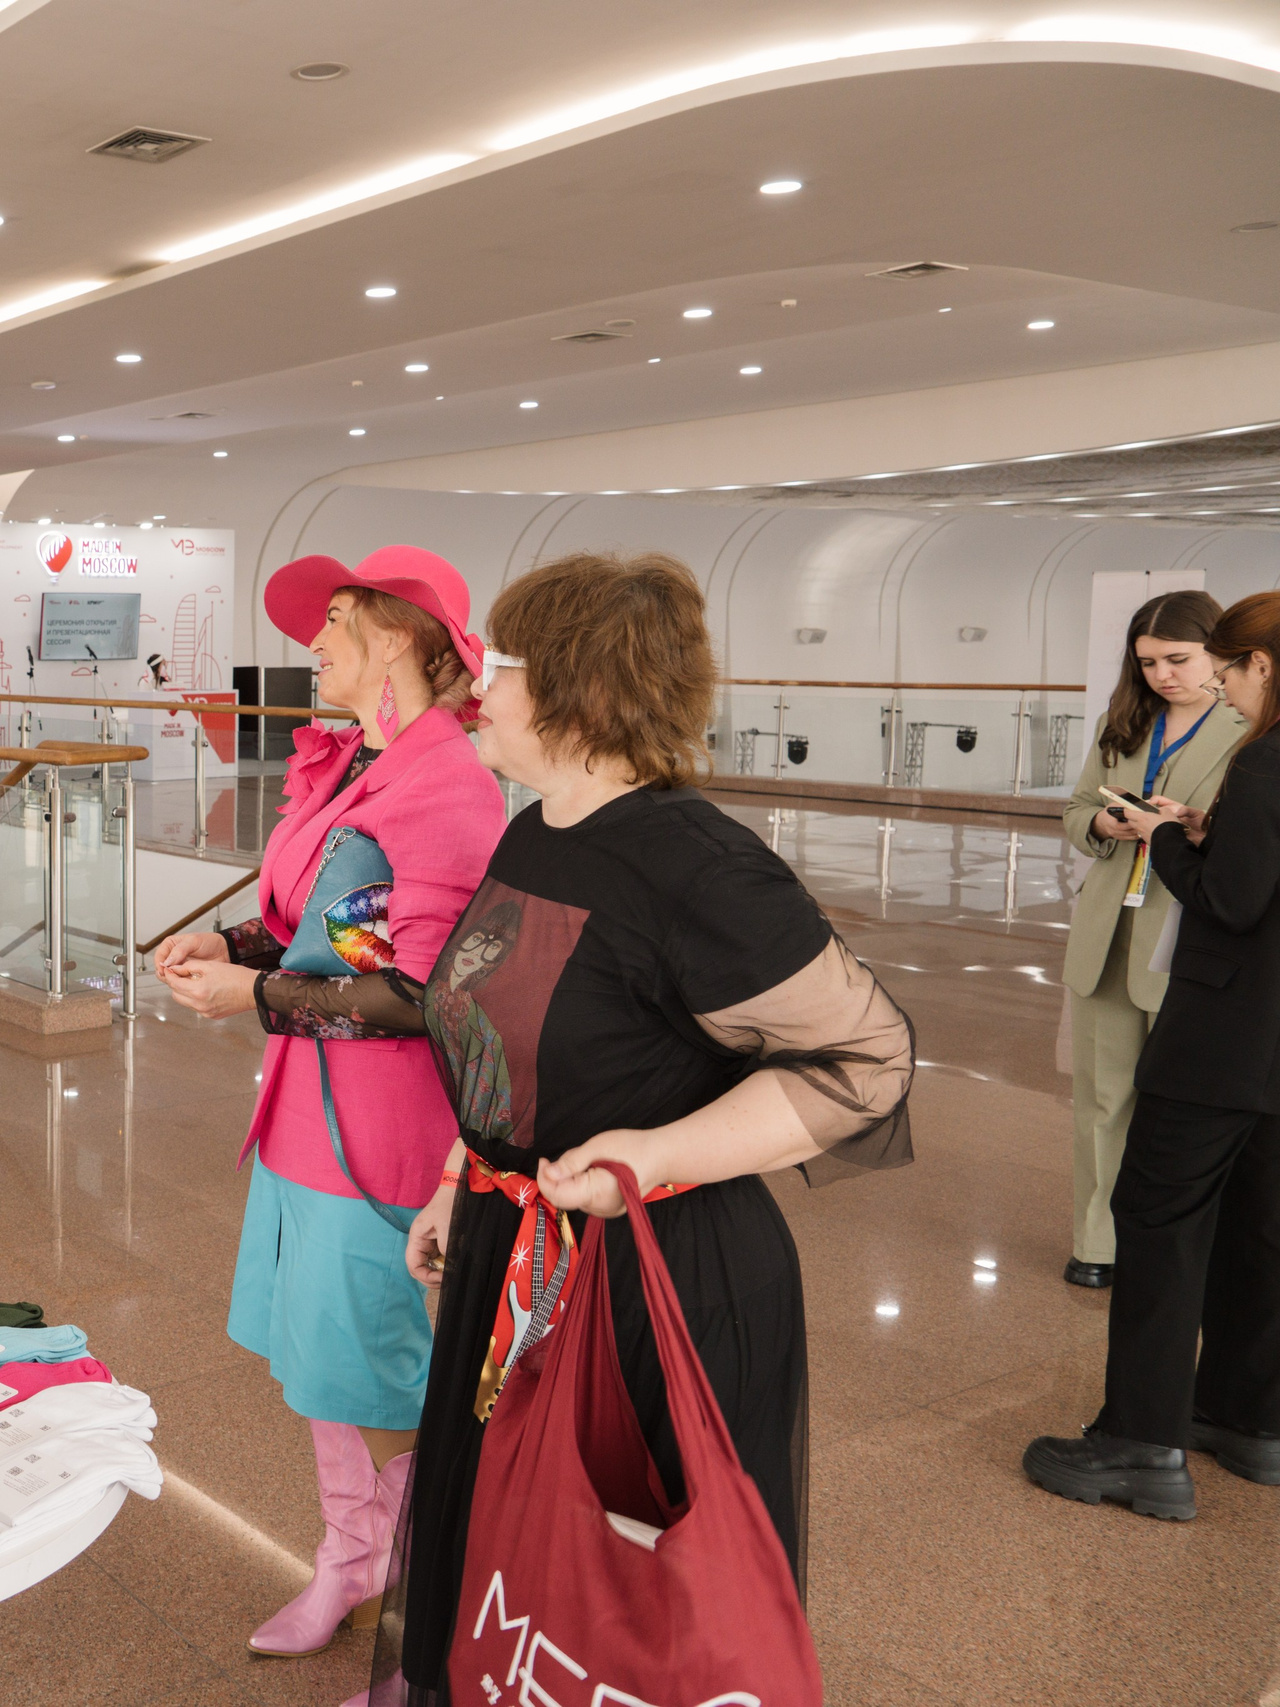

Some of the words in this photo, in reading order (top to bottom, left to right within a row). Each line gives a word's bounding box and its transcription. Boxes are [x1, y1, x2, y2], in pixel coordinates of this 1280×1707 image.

[81, 540, 110, 554] MADE
[111, 540, 122, 554] IN
[81, 557, 138, 574] MOSCOW
[46, 619, 85, 627] ЦЕРЕМОНИЯ
[85, 619, 117, 627] ОТКРЫТИЯ
[161, 730, 185, 738] MOSCOW
